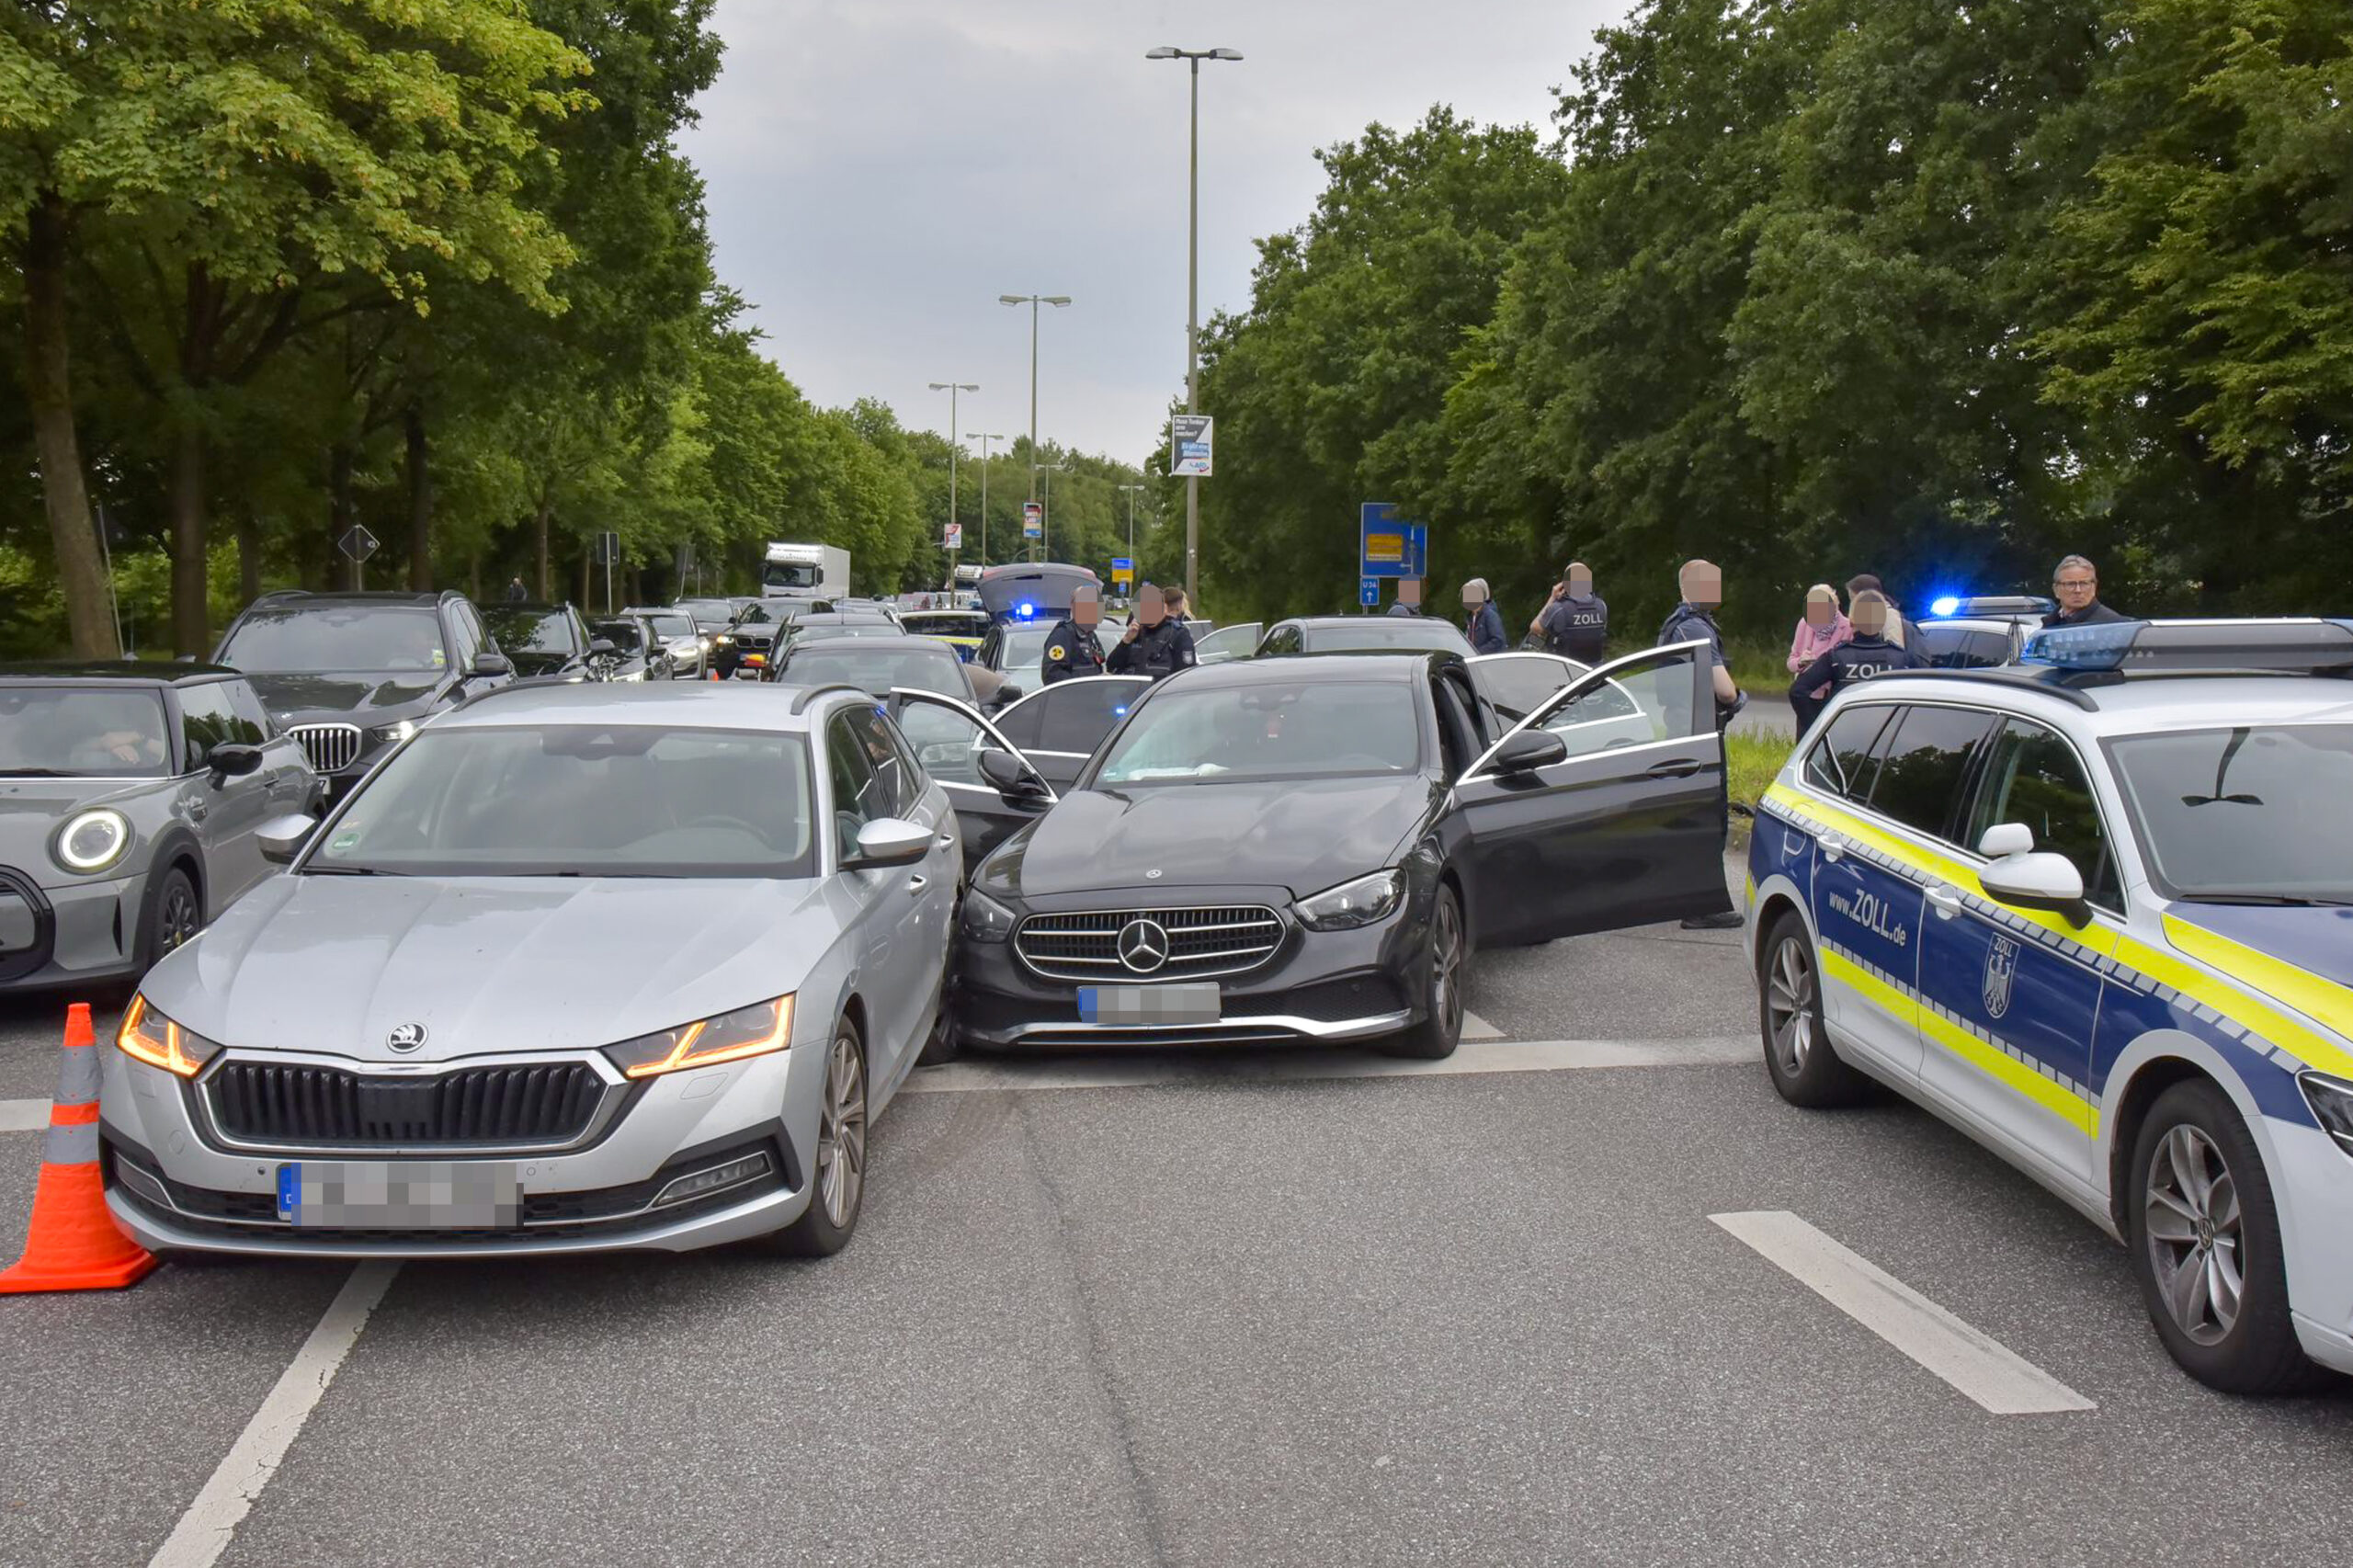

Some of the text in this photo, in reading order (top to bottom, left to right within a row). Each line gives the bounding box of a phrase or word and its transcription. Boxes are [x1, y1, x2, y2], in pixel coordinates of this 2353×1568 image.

[1573, 613, 1603, 625] ZOLL
[1829, 887, 1906, 947] www.ZOLL.de
[1995, 937, 2013, 957] ZOLL
